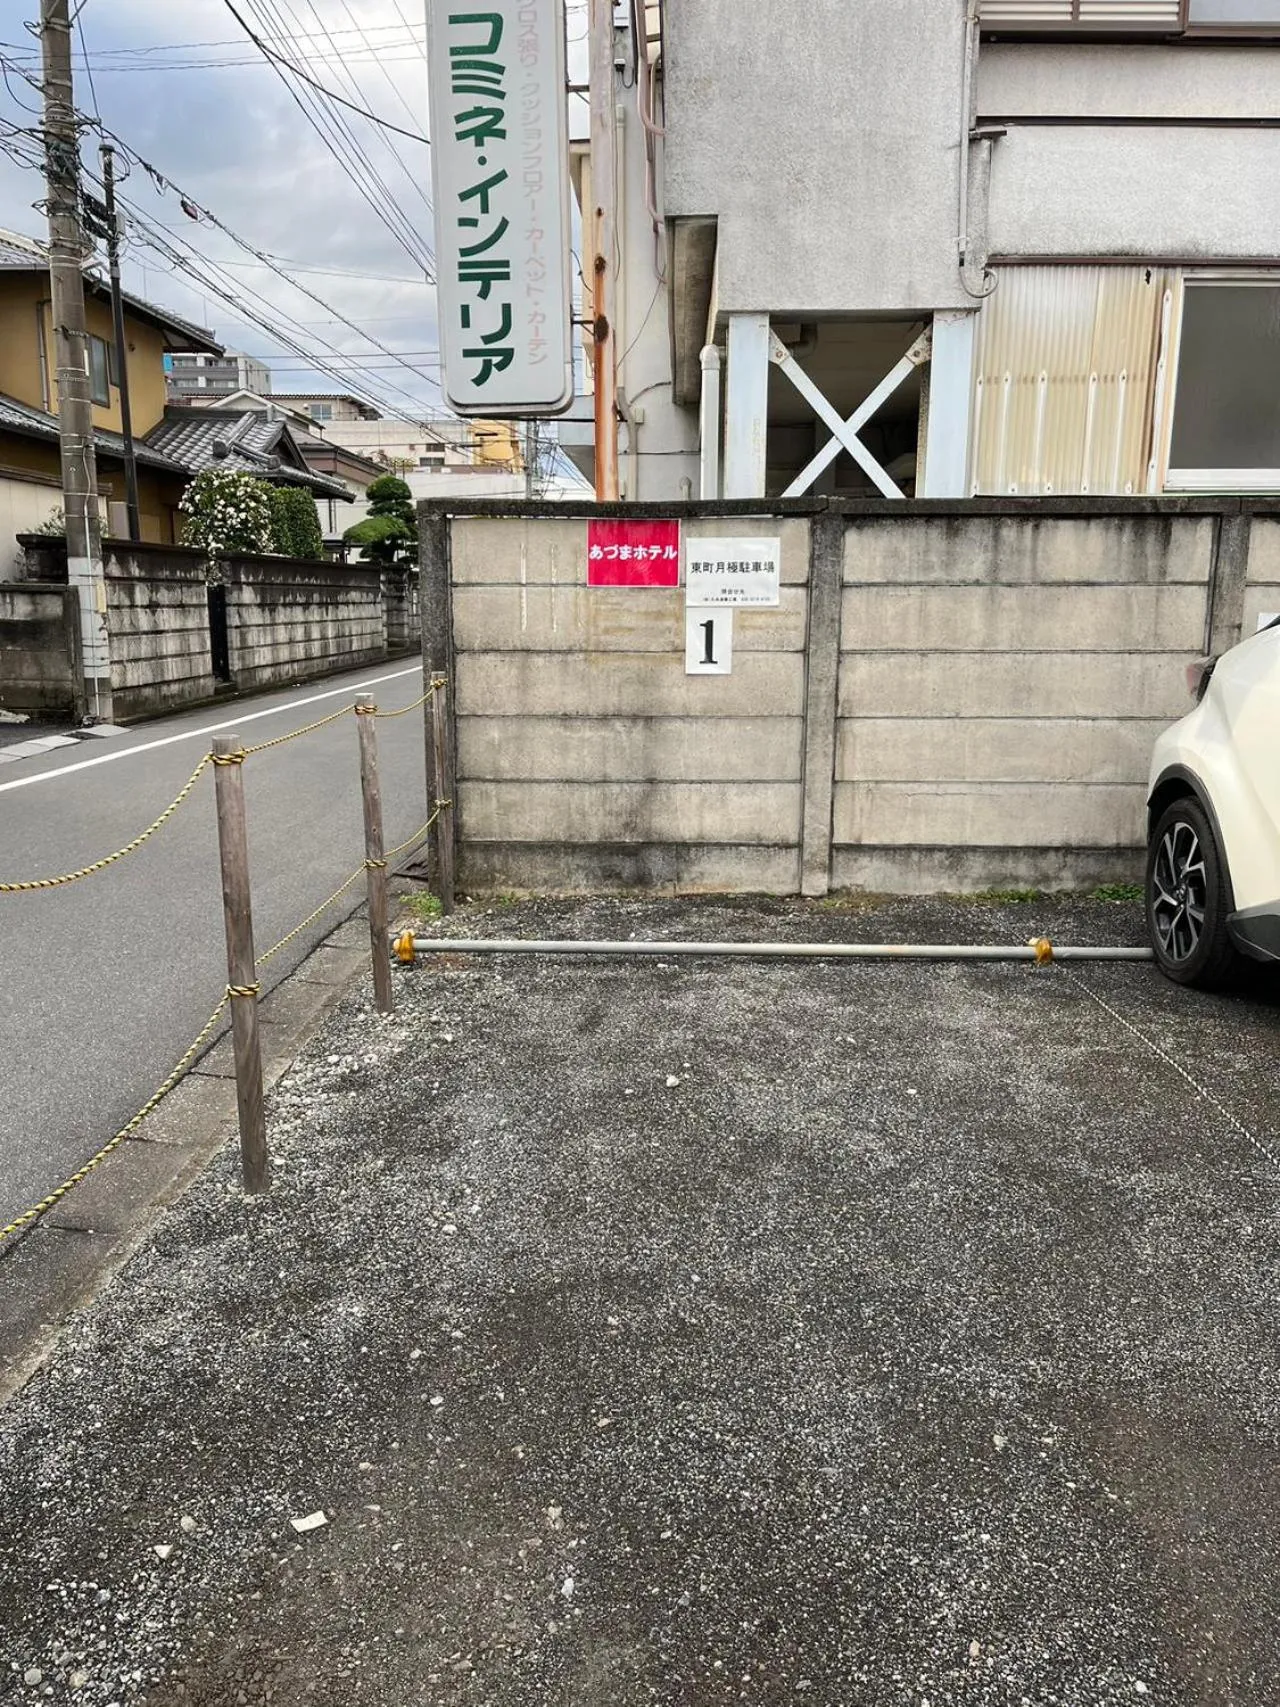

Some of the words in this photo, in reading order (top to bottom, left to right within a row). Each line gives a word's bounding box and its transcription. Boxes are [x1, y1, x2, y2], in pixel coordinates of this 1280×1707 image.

[448, 13, 515, 387] コミネ・インテリア
[588, 545, 678, 559] あづまホテル
[691, 561, 775, 574] 東町月極駐車場
[699, 619, 718, 665] 1
